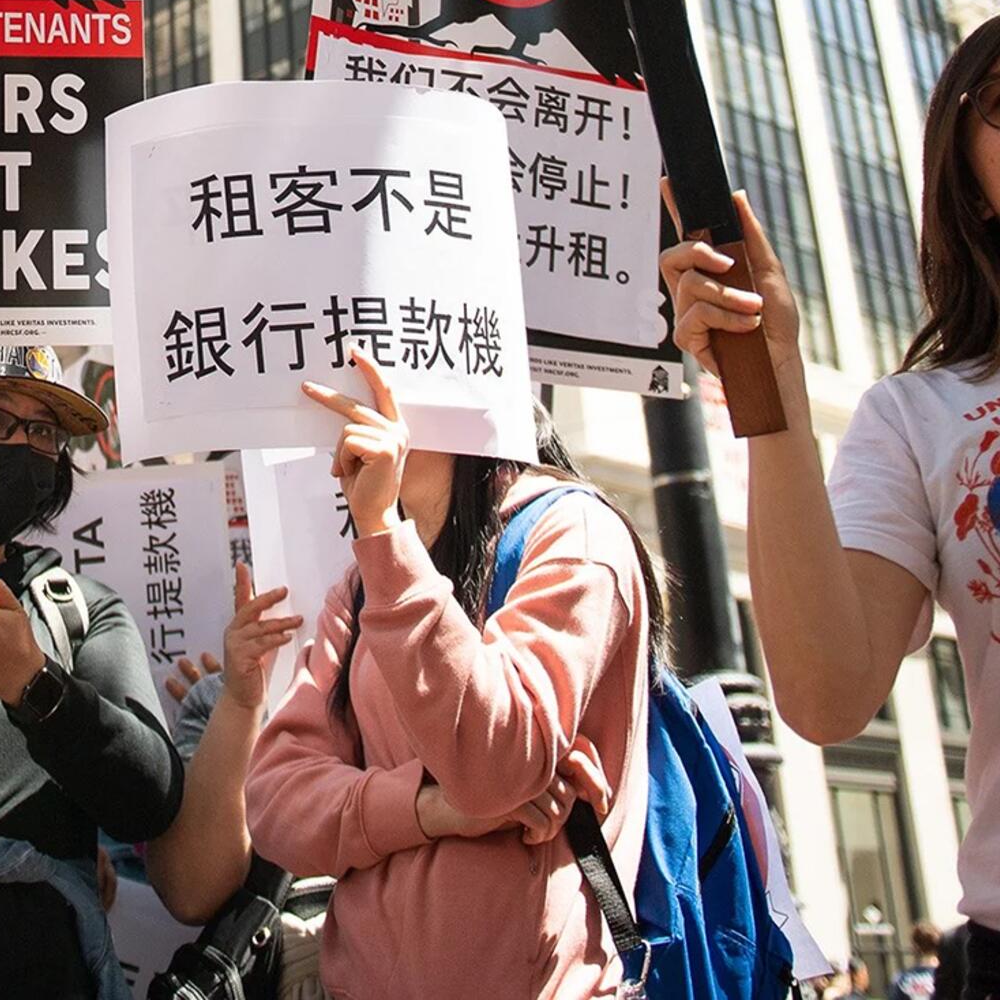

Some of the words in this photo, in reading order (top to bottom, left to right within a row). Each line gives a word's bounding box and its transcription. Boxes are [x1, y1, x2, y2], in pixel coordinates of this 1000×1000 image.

[189, 164, 474, 243] 租客不是
[162, 294, 504, 385] 銀行提款機
[139, 487, 185, 664] 行提款機
